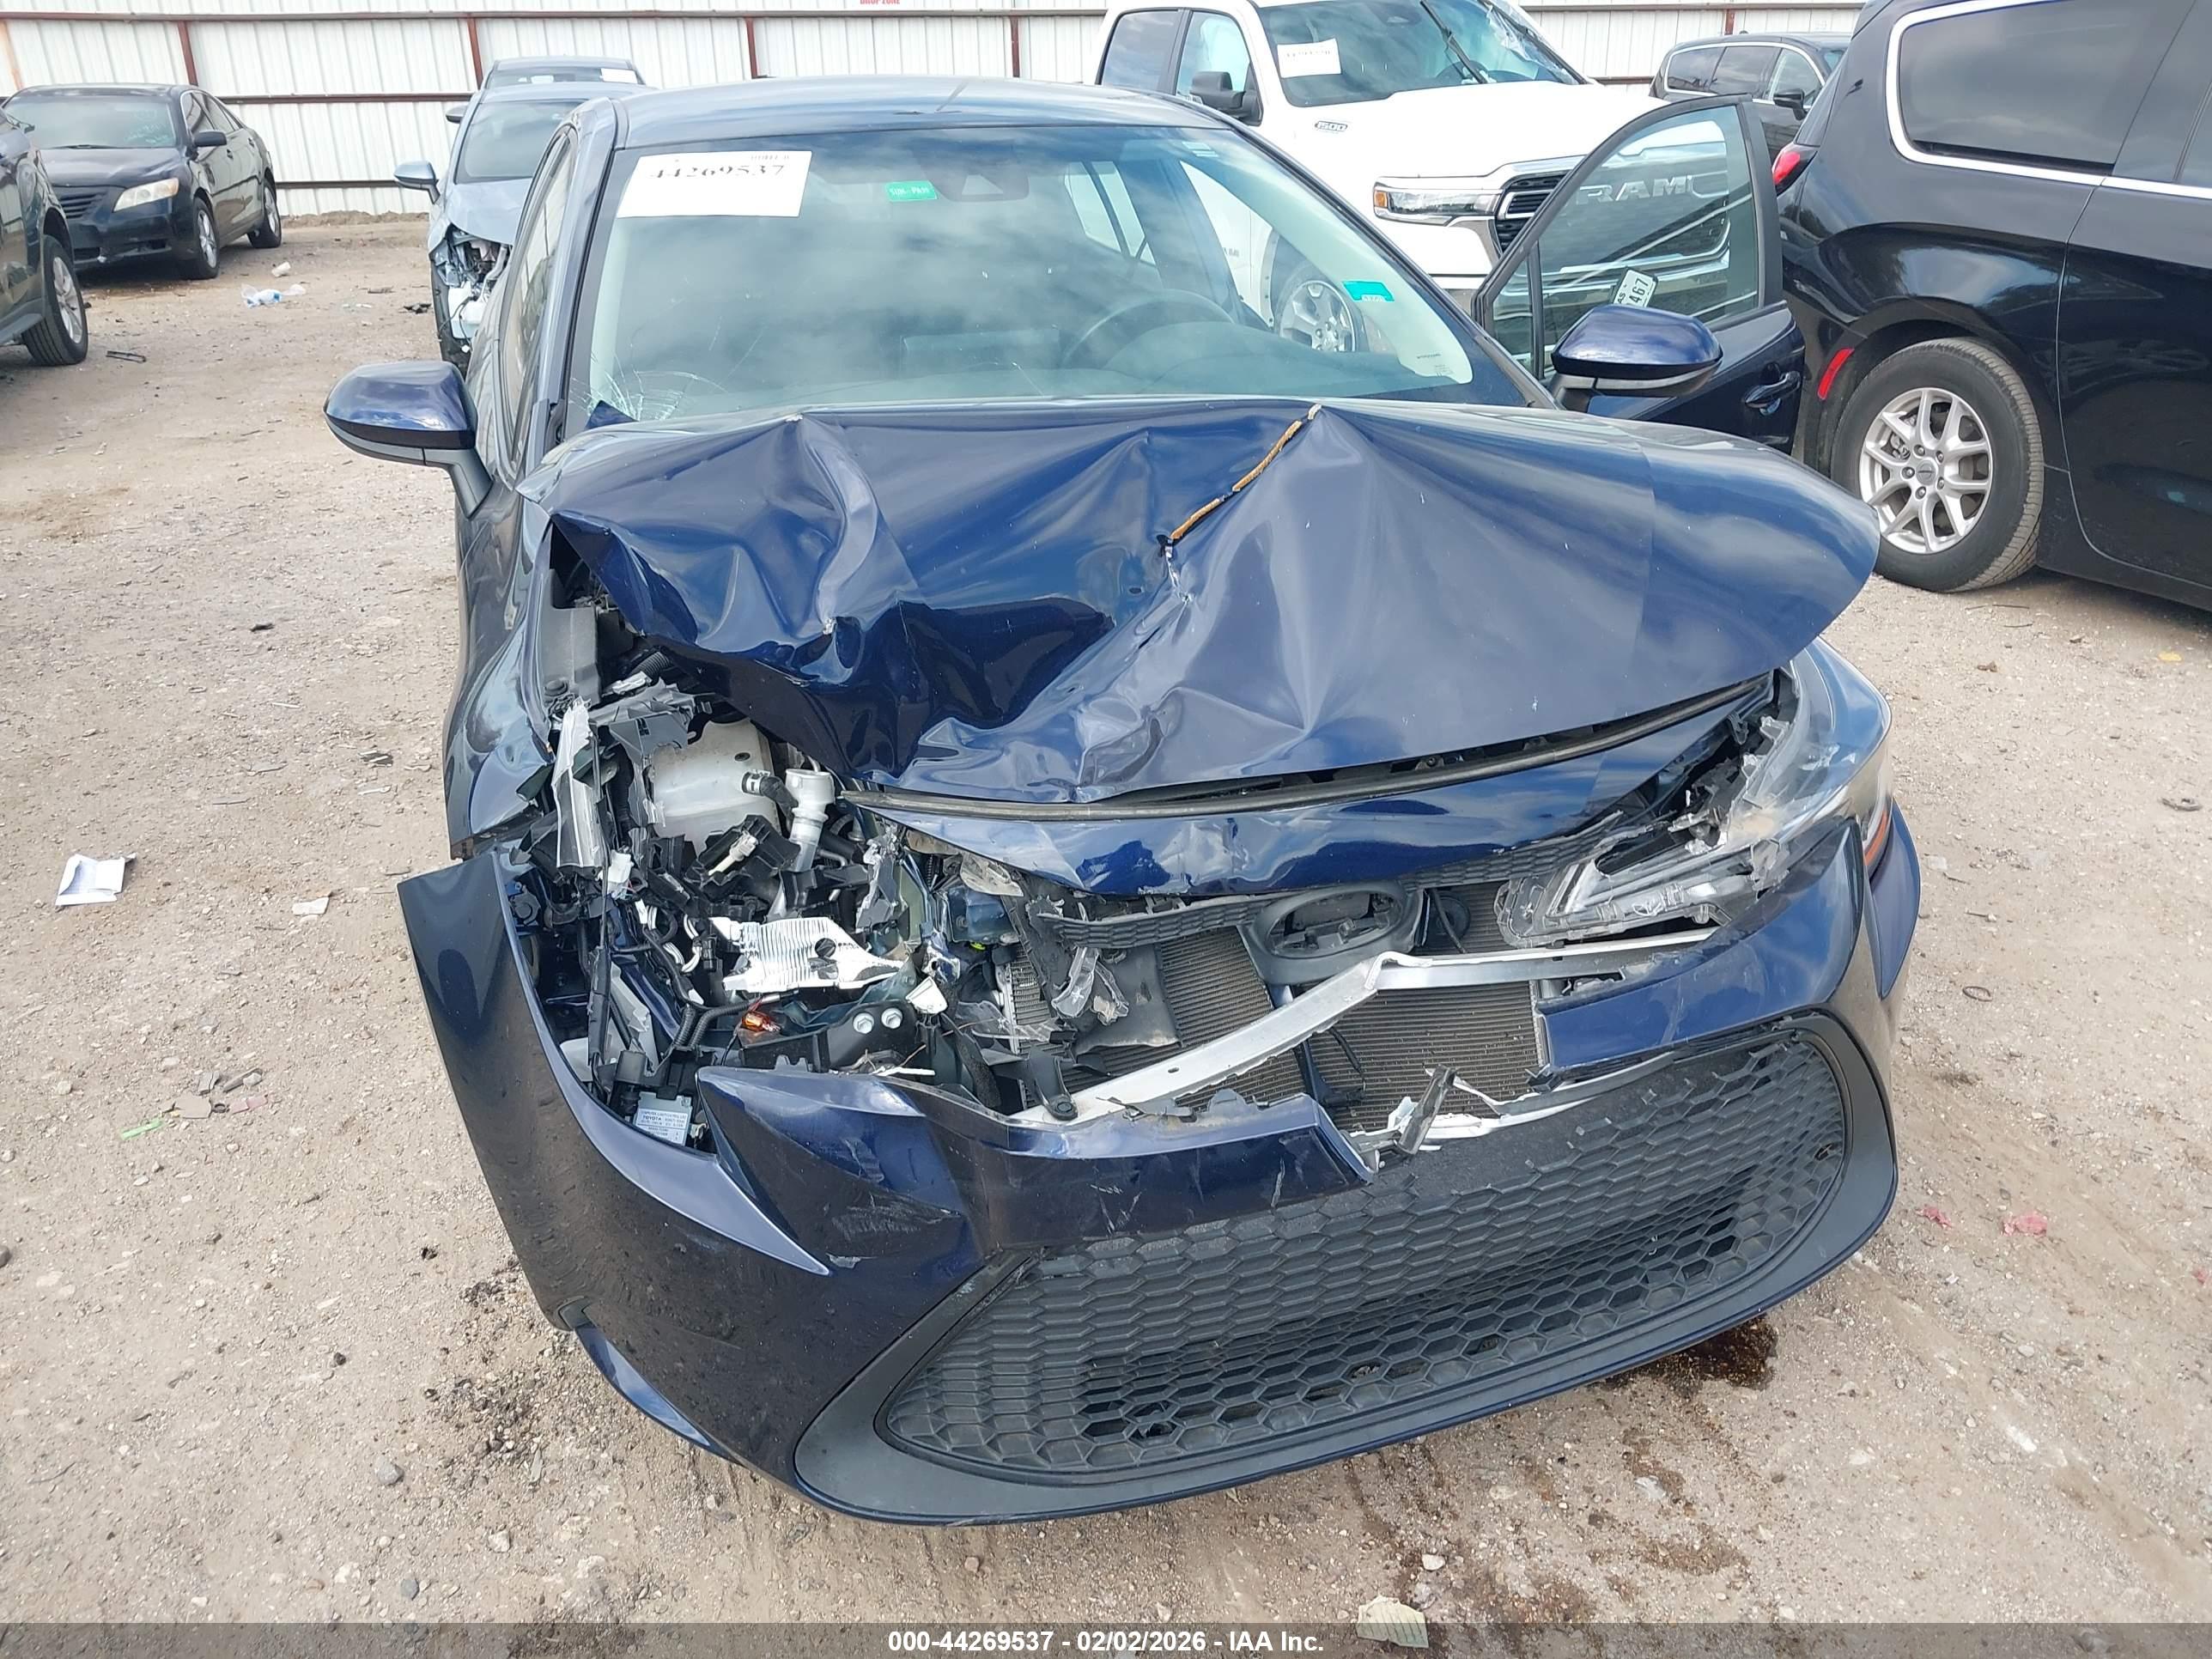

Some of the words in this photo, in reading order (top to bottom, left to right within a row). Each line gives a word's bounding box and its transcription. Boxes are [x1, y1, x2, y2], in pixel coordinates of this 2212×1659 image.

[1316, 121, 1347, 131] 1500
[1577, 174, 1690, 205] RAM
[1628, 277, 1649, 304] 467
